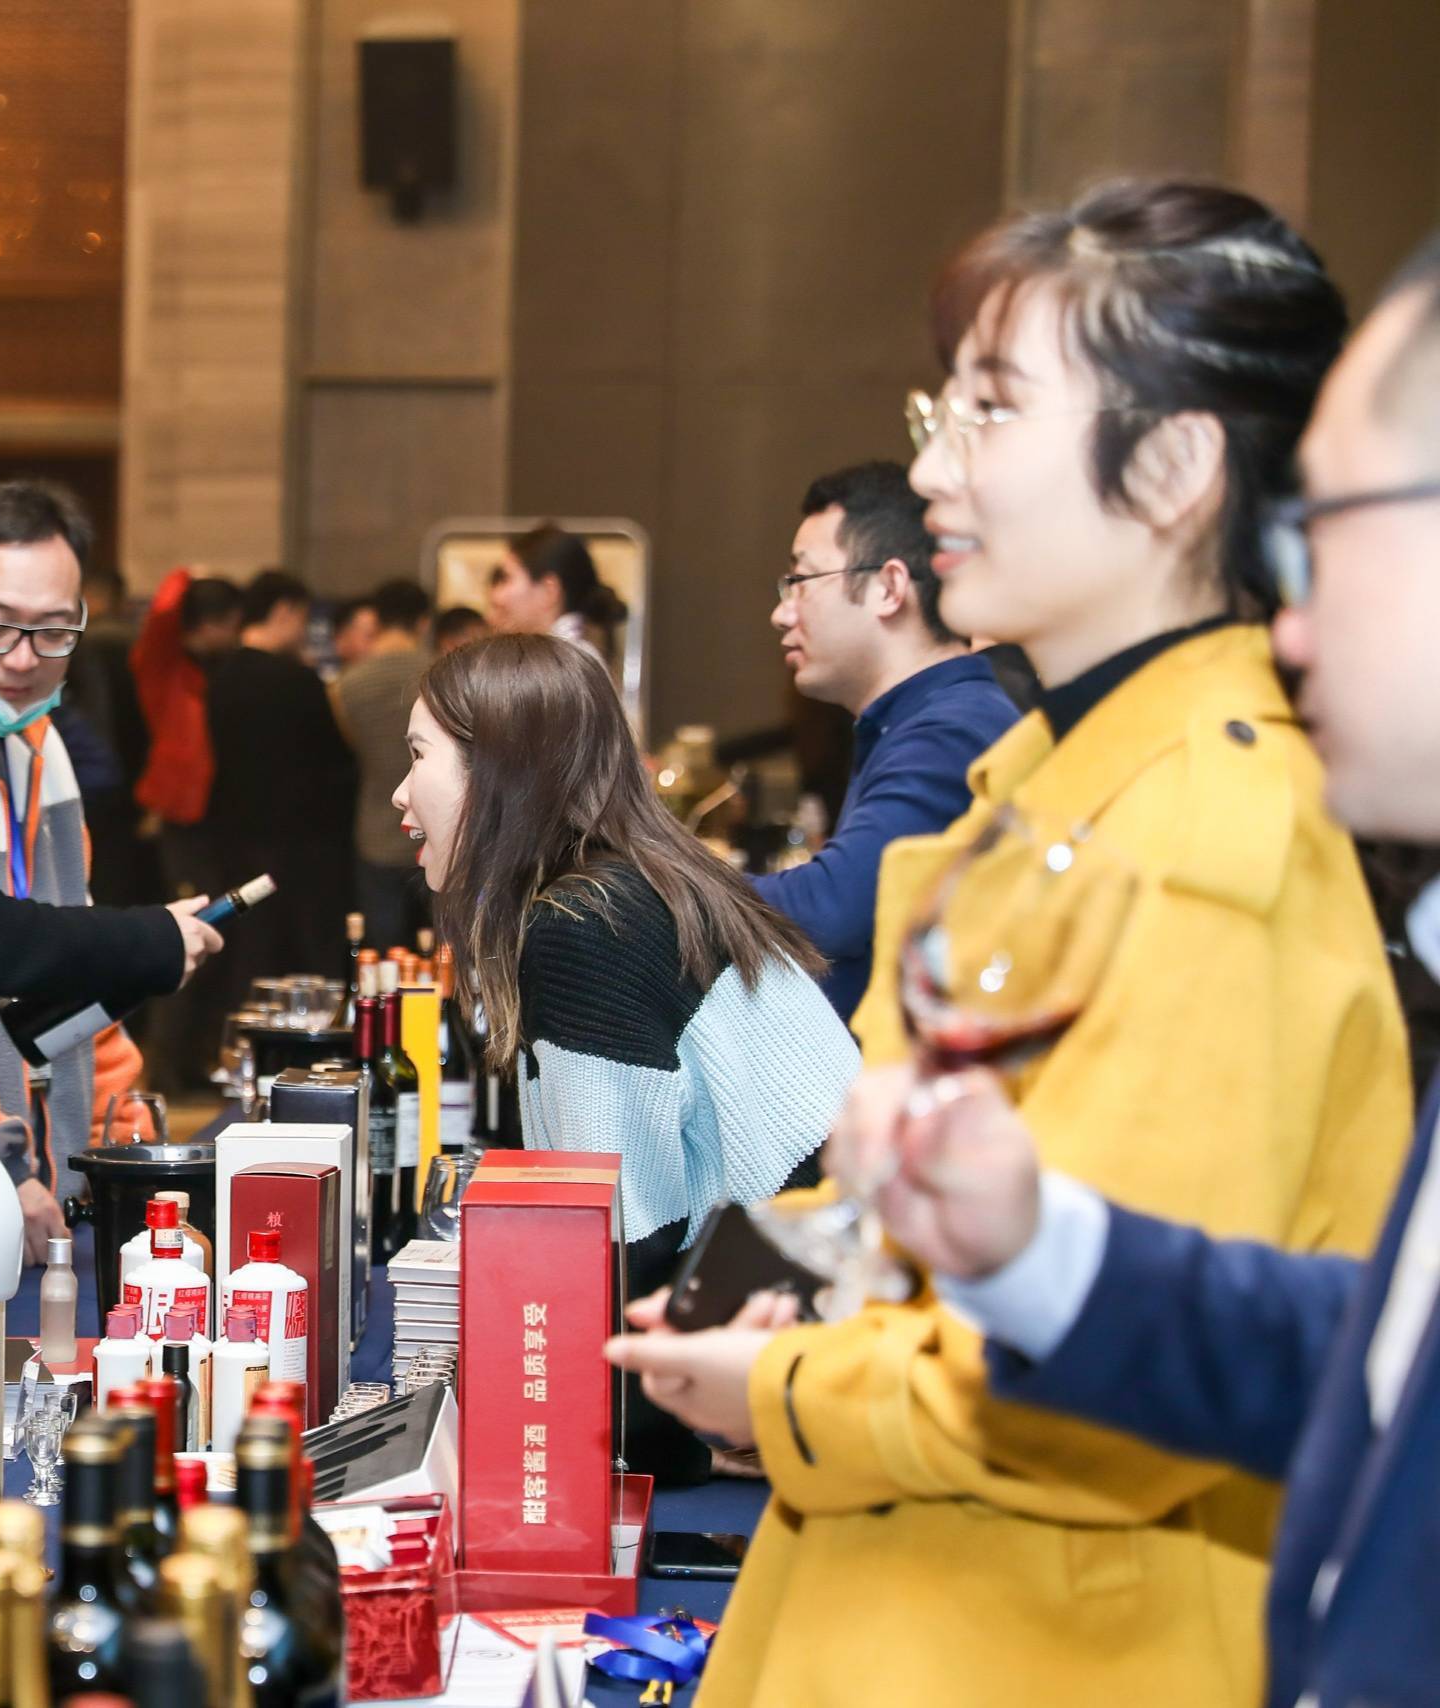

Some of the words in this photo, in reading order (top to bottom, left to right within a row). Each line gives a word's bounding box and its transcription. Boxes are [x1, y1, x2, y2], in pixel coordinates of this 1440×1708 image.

[523, 1302, 548, 1402] 品质享受
[523, 1424, 548, 1525] 酣客酱酒
